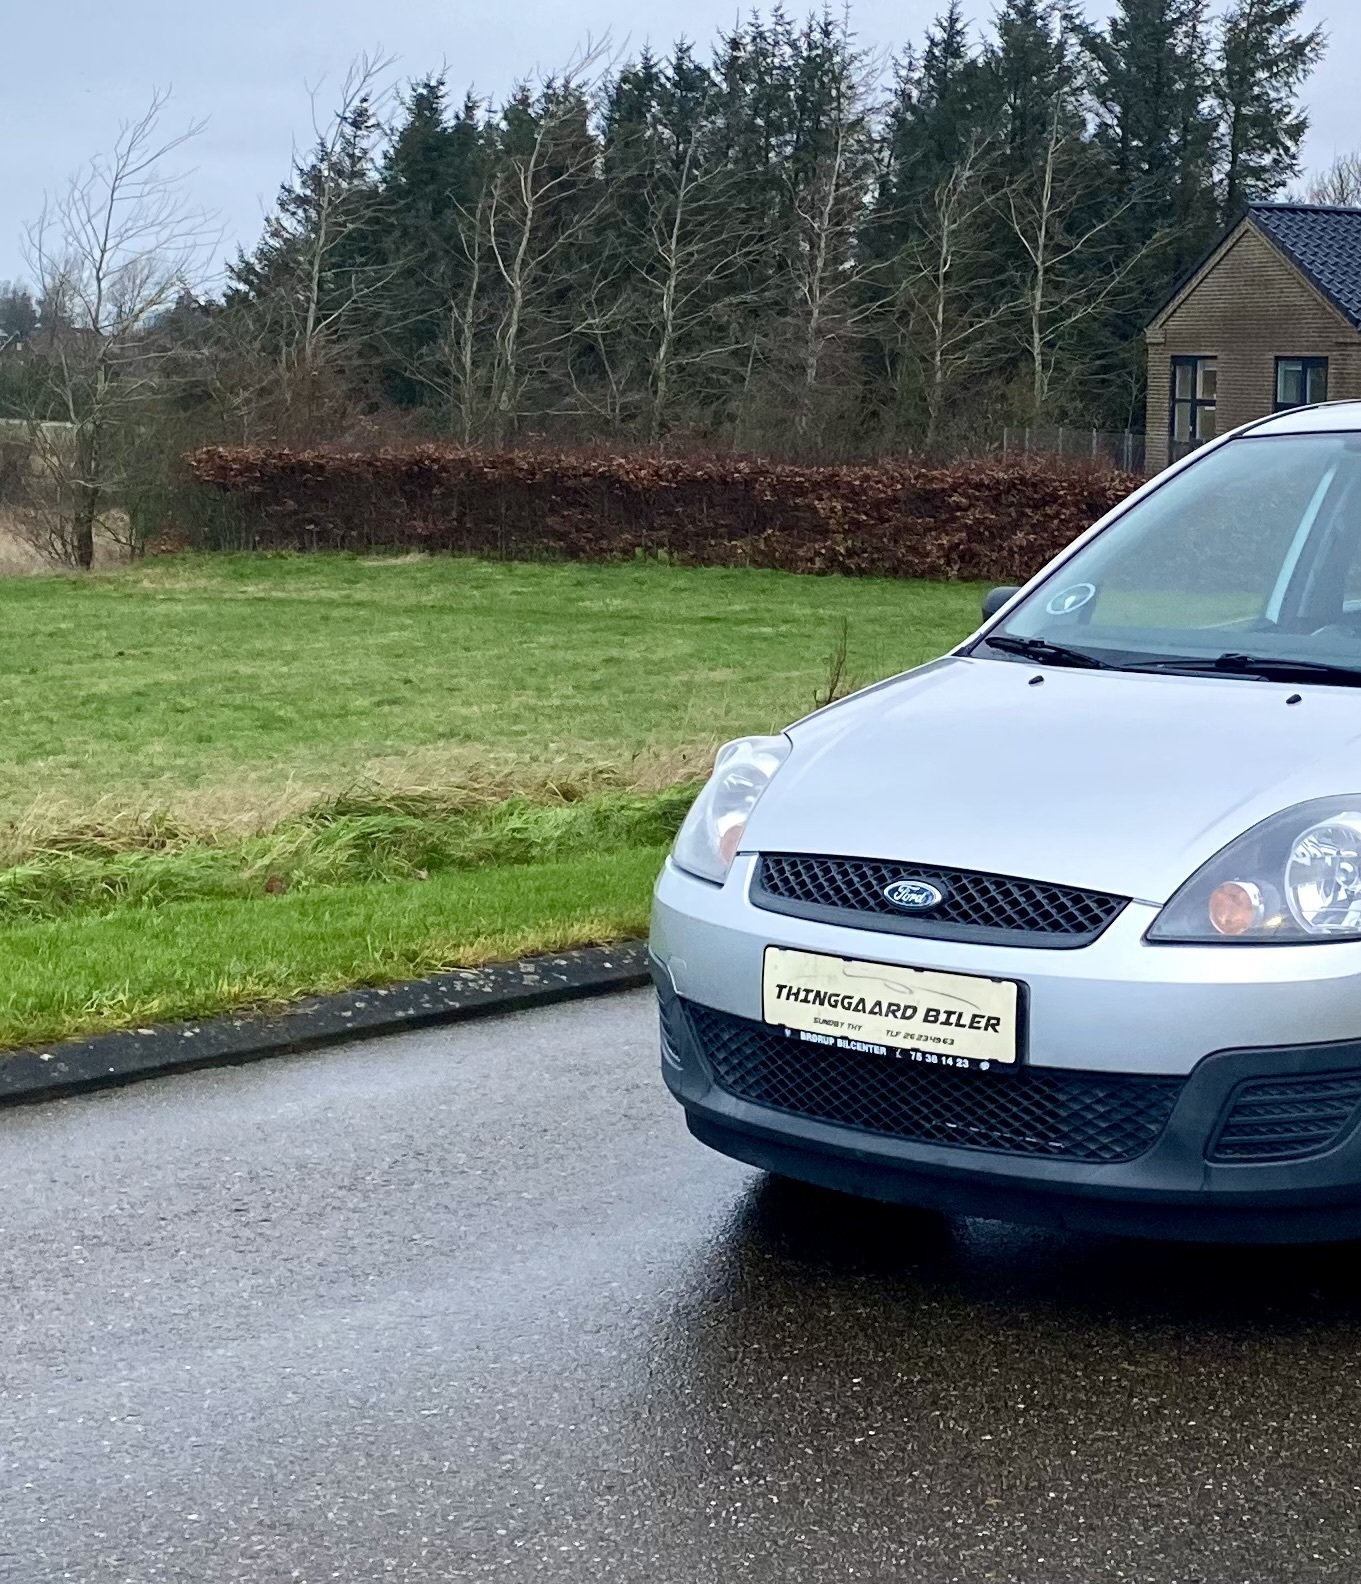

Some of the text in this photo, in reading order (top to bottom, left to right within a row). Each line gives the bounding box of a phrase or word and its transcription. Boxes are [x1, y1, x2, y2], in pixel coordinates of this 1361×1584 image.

[894, 885, 928, 903] Ford
[776, 984, 1001, 1033] THINGGAARD BILER
[847, 1023, 863, 1031] THY
[836, 1038, 887, 1056] BILCENTER
[941, 1056, 954, 1066] 14
[955, 1058, 970, 1068] 23
